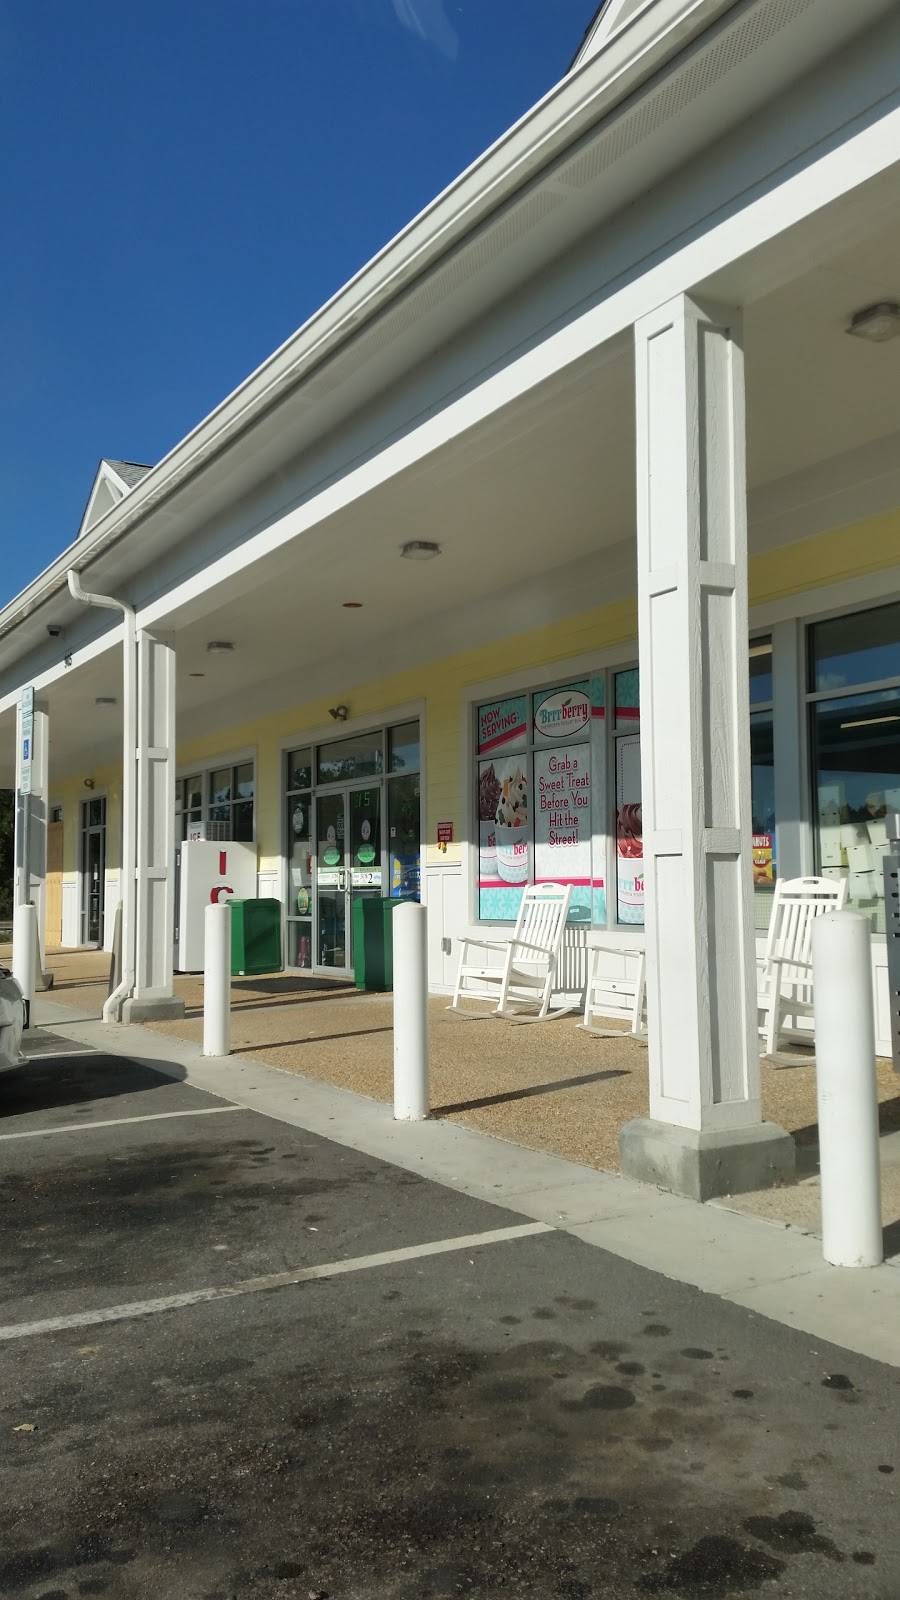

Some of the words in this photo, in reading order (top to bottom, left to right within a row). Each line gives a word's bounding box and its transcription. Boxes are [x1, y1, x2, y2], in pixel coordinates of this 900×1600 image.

[481, 706, 501, 727] NOW
[540, 703, 588, 724] Brrrberry
[549, 754, 571, 772] Grab
[573, 759, 578, 769] a
[539, 776, 564, 792] Sweet
[567, 771, 589, 788] Treat
[540, 792, 569, 810] Before
[571, 790, 588, 806] You
[549, 811, 562, 827] Hit
[564, 810, 579, 825] the
[549, 828, 579, 846] Street!
